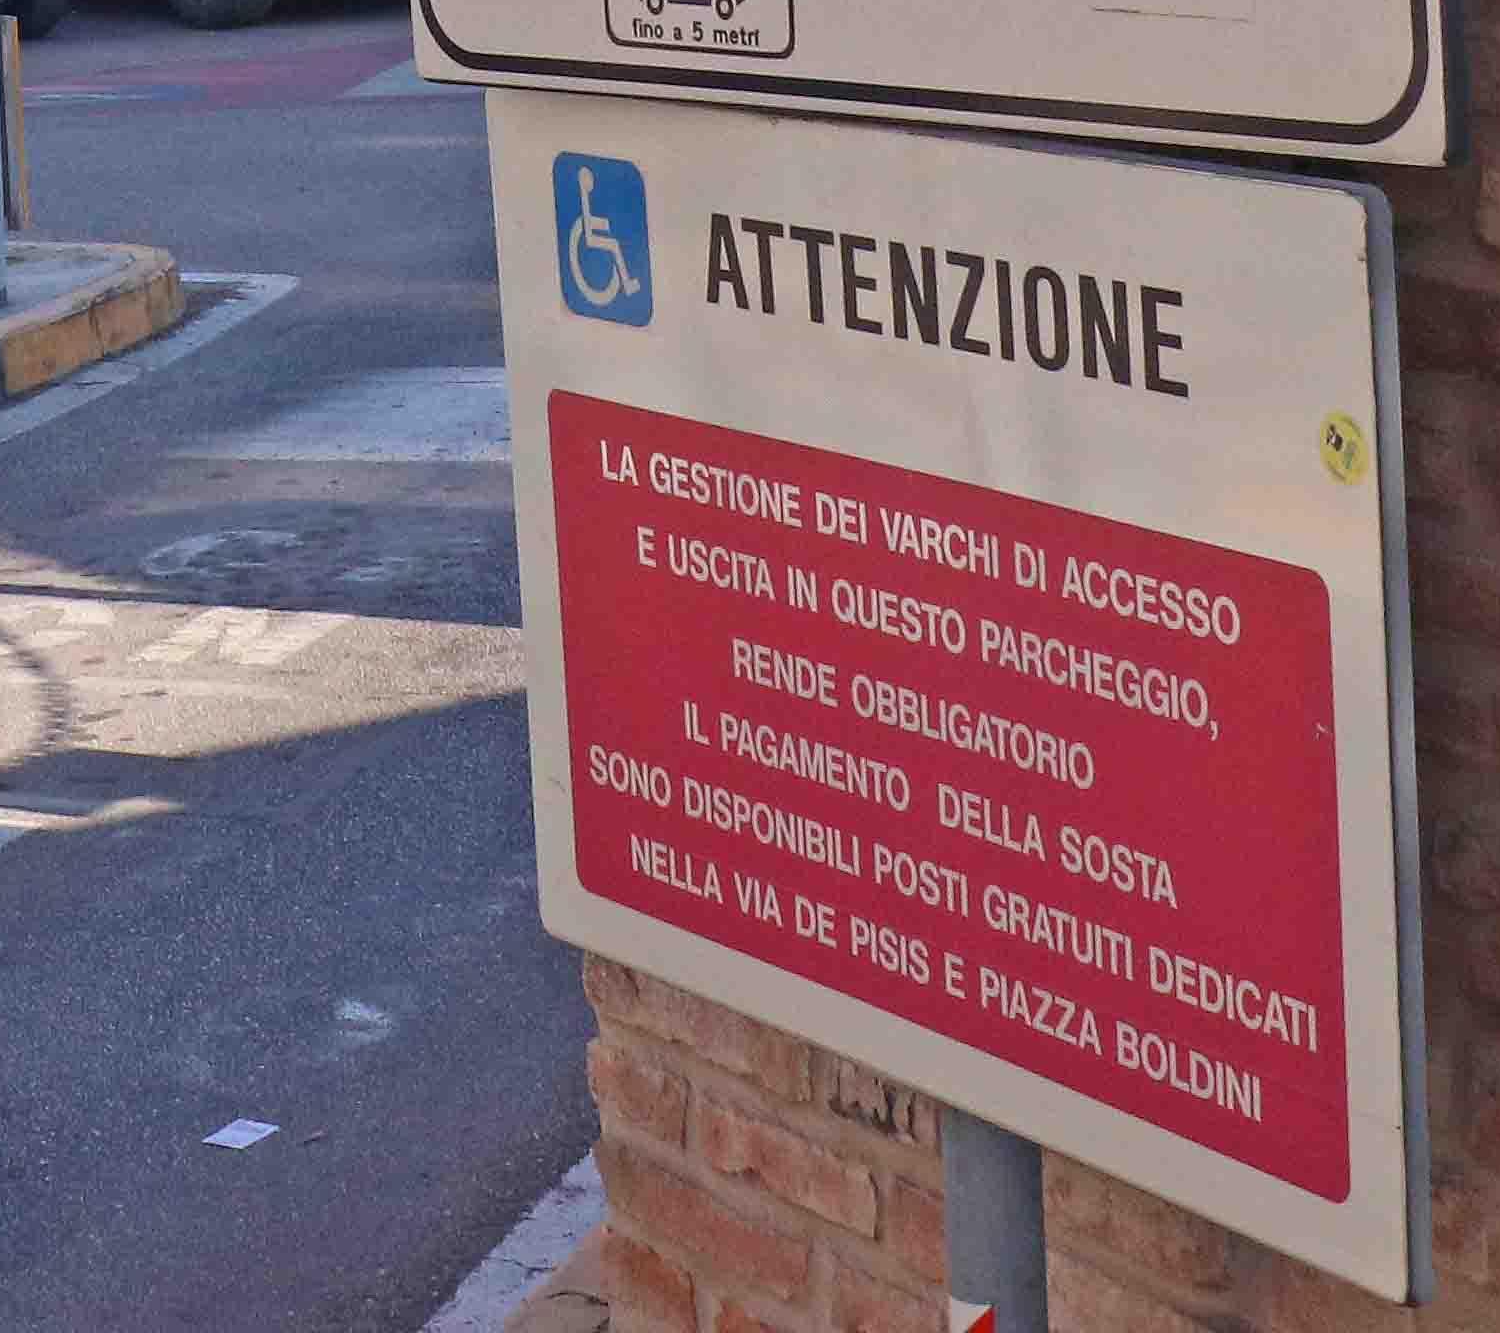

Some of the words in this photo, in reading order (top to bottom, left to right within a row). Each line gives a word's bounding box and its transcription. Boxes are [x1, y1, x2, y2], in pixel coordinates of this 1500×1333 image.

[632, 18, 664, 40] fino
[673, 24, 683, 41] a
[692, 20, 704, 42] 5
[713, 26, 760, 47] metri
[704, 212, 1191, 399] ATTENZIONE
[600, 439, 639, 486] LA
[648, 451, 803, 528] GESTIONE
[814, 491, 868, 544] DEI
[879, 507, 1000, 579] VARCHI
[1014, 541, 1048, 592] DI
[1062, 556, 1242, 645] ACCESSO
[636, 525, 657, 567] E
[668, 533, 776, 601] USCITA
[787, 565, 818, 613] IN
[831, 578, 966, 654] QUESTO
[980, 618, 1220, 741] PARCHEGGIO,
[683, 700, 711, 746] IL
[719, 711, 911, 812] PAGAMENTO
[937, 782, 1046, 861] DELLA
[1059, 825, 1178, 910] SOSTA
[732, 637, 839, 708] RENDE
[851, 674, 1095, 790] OBBLIGATORIO
[589, 744, 672, 807] SONO
[682, 775, 862, 877] DISPONIBILI
[872, 842, 970, 917] POSTI
[982, 884, 1135, 982] GRATUITI
[1148, 946, 1319, 1053] DEDICATI
[630, 833, 724, 904] NELLA
[734, 871, 784, 927] VIA
[795, 893, 837, 948] DE
[850, 915, 931, 985] PISIS
[943, 951, 967, 999] E
[979, 965, 1103, 1056] PIAZZA
[1115, 1020, 1263, 1124] BOLDINI
